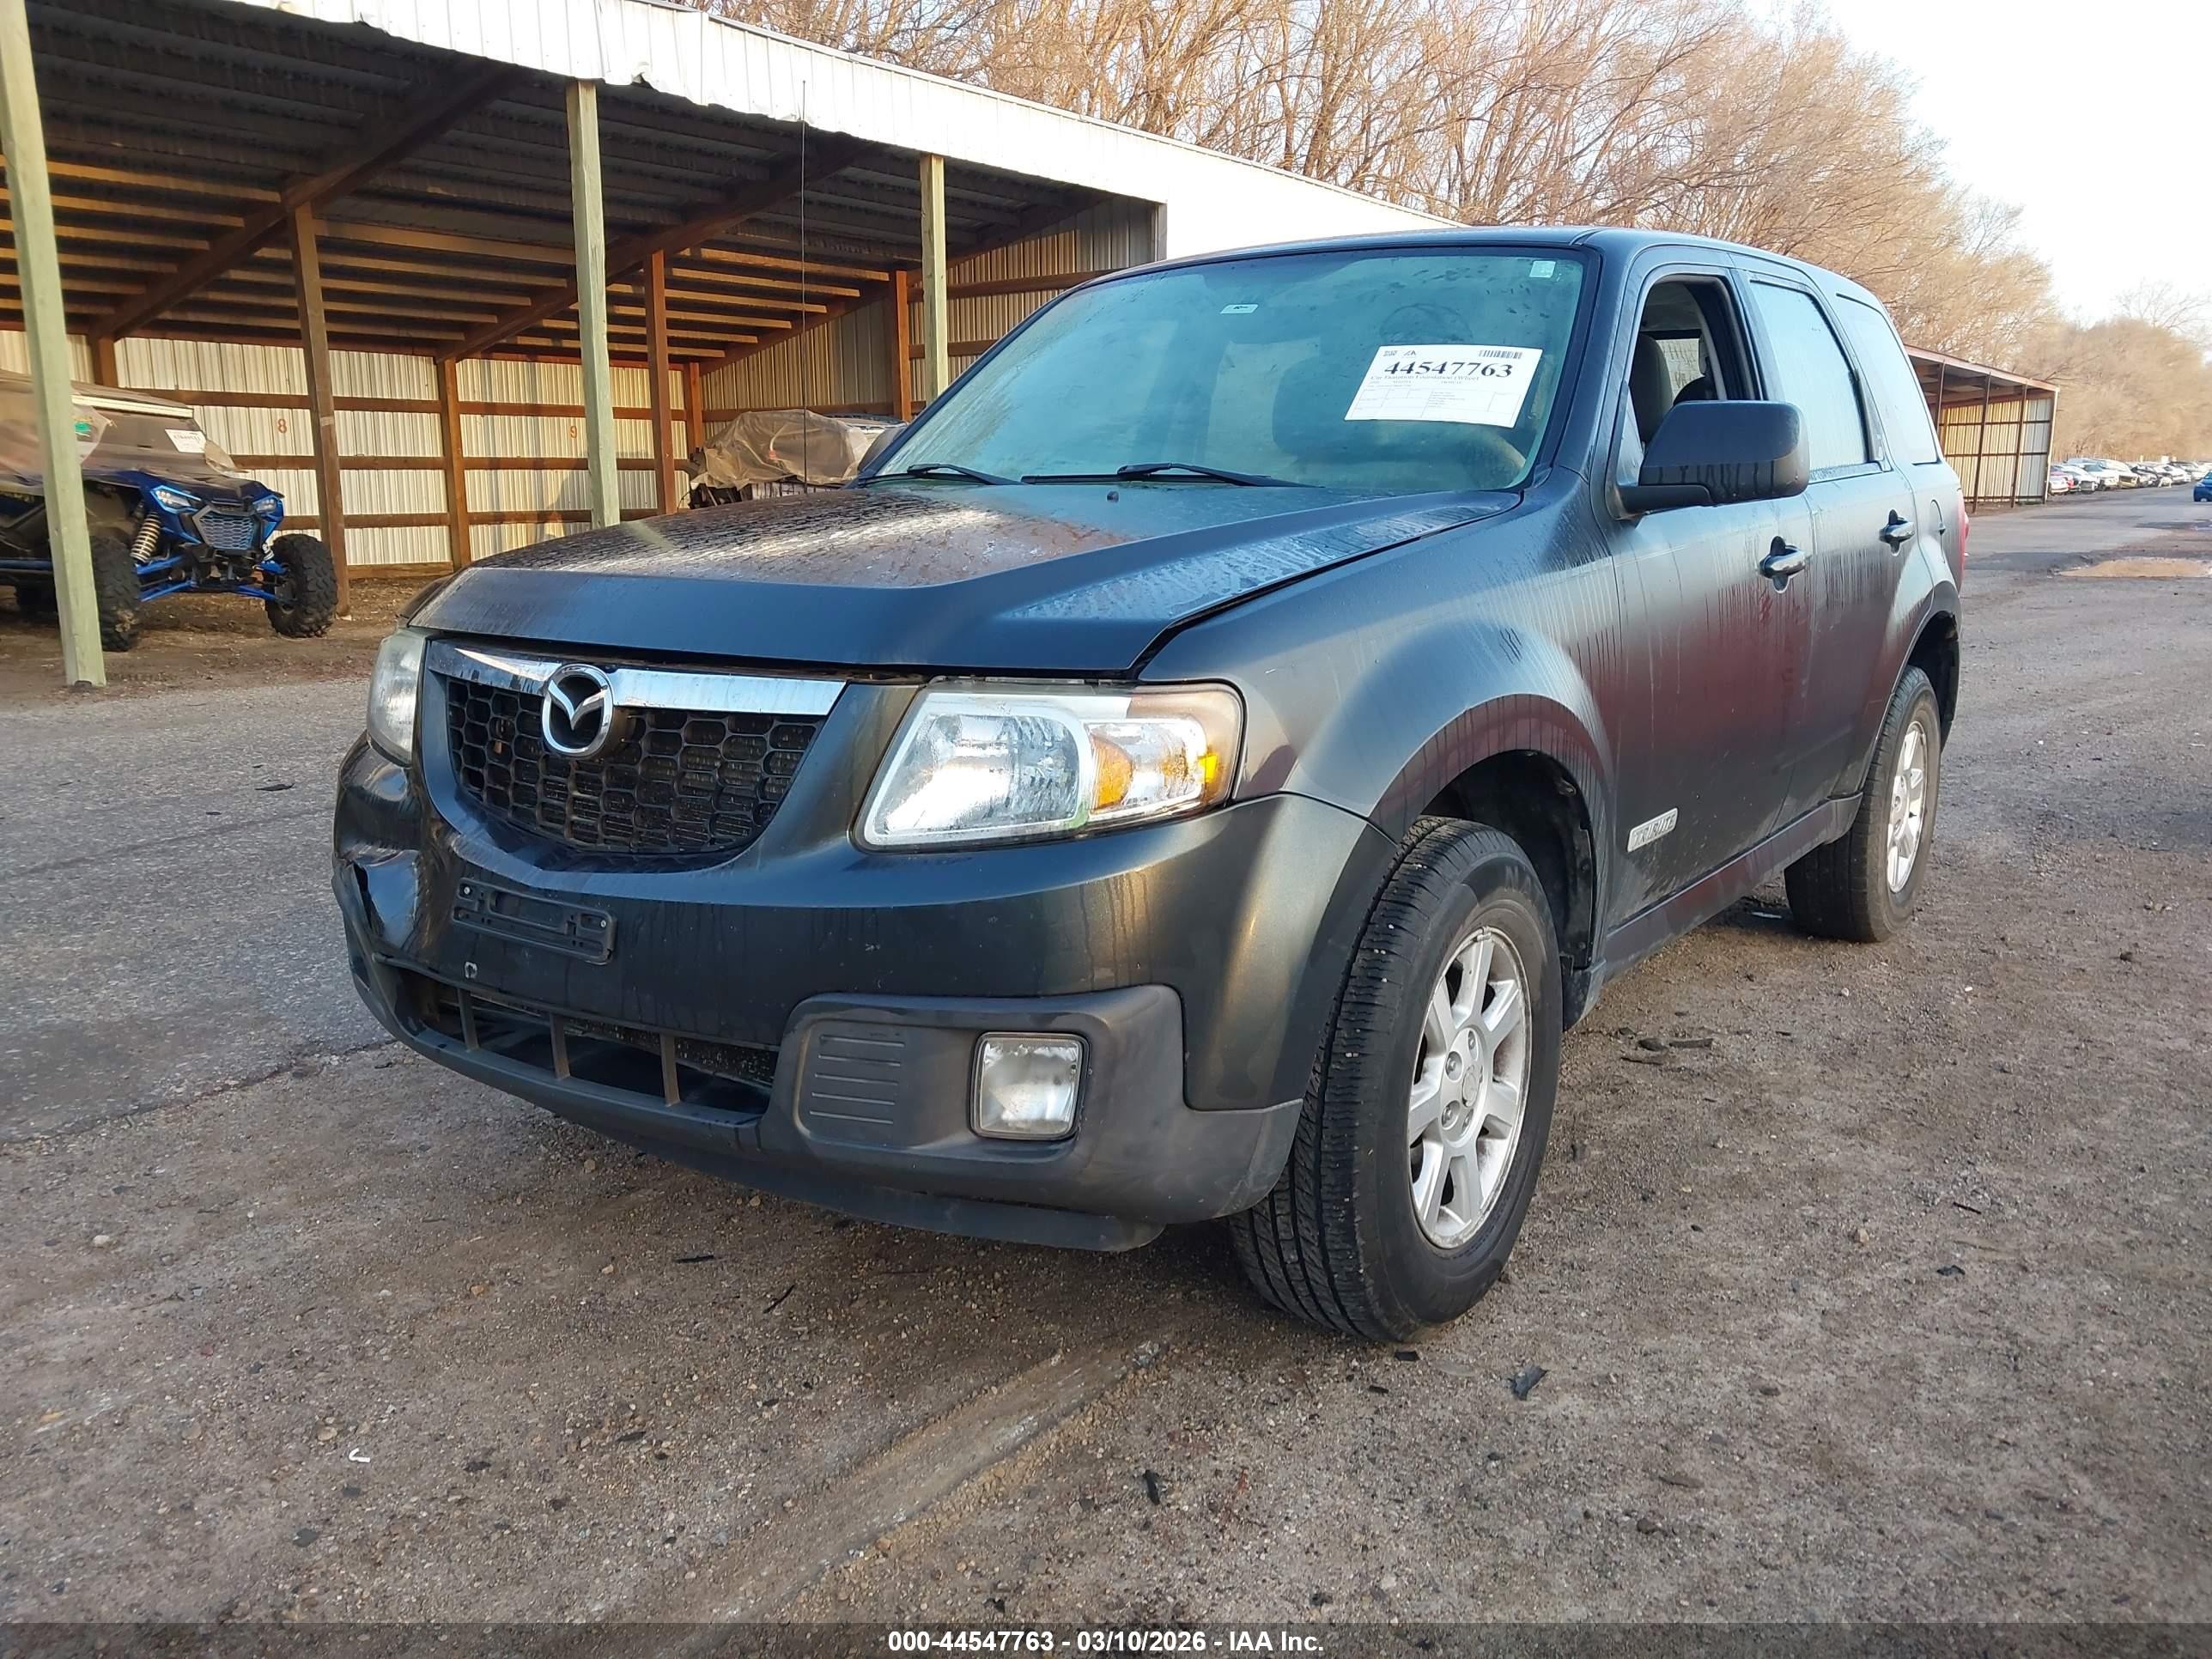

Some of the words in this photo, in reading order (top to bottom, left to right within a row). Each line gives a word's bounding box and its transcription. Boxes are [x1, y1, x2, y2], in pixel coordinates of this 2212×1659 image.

[1384, 362, 1513, 378] 44547763
[277, 418, 288, 434] 8
[569, 425, 578, 439] 9
[1631, 811, 1676, 847] TRIBUTE
